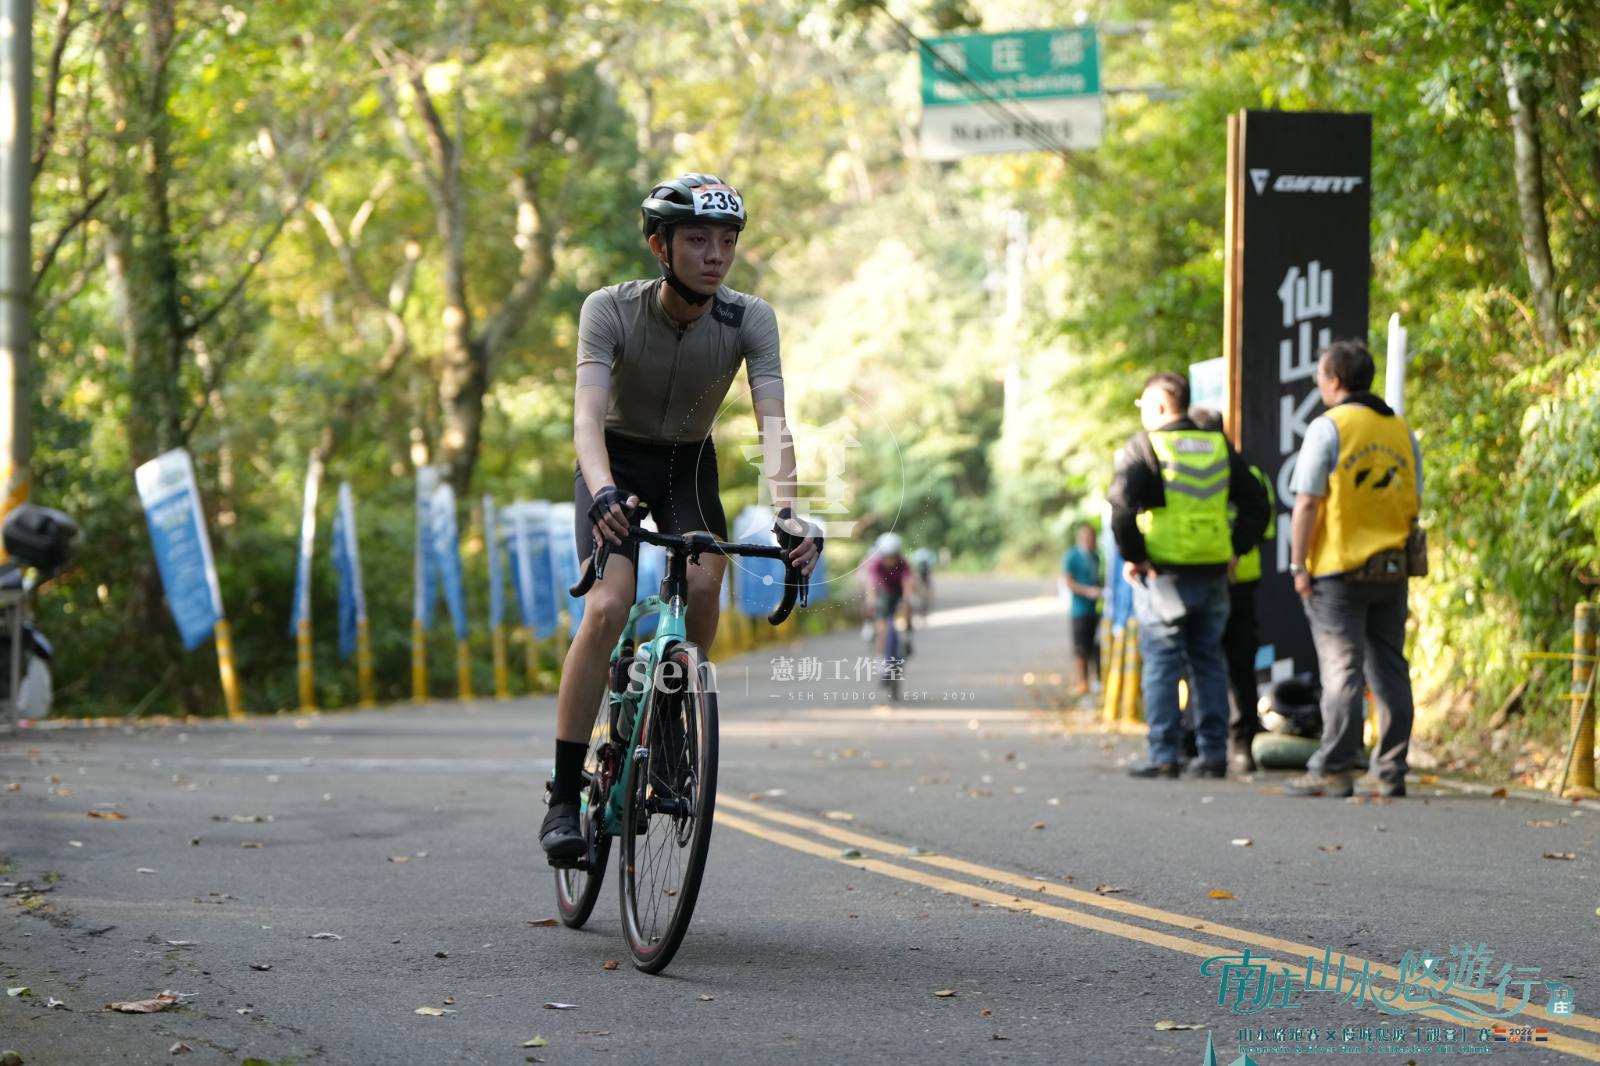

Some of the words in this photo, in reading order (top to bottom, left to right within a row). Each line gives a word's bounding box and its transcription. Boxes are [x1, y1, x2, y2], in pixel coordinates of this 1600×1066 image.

[1273, 174, 1363, 193] GIANT
[700, 191, 740, 213] 239
[1276, 259, 1334, 574] 仙山K
